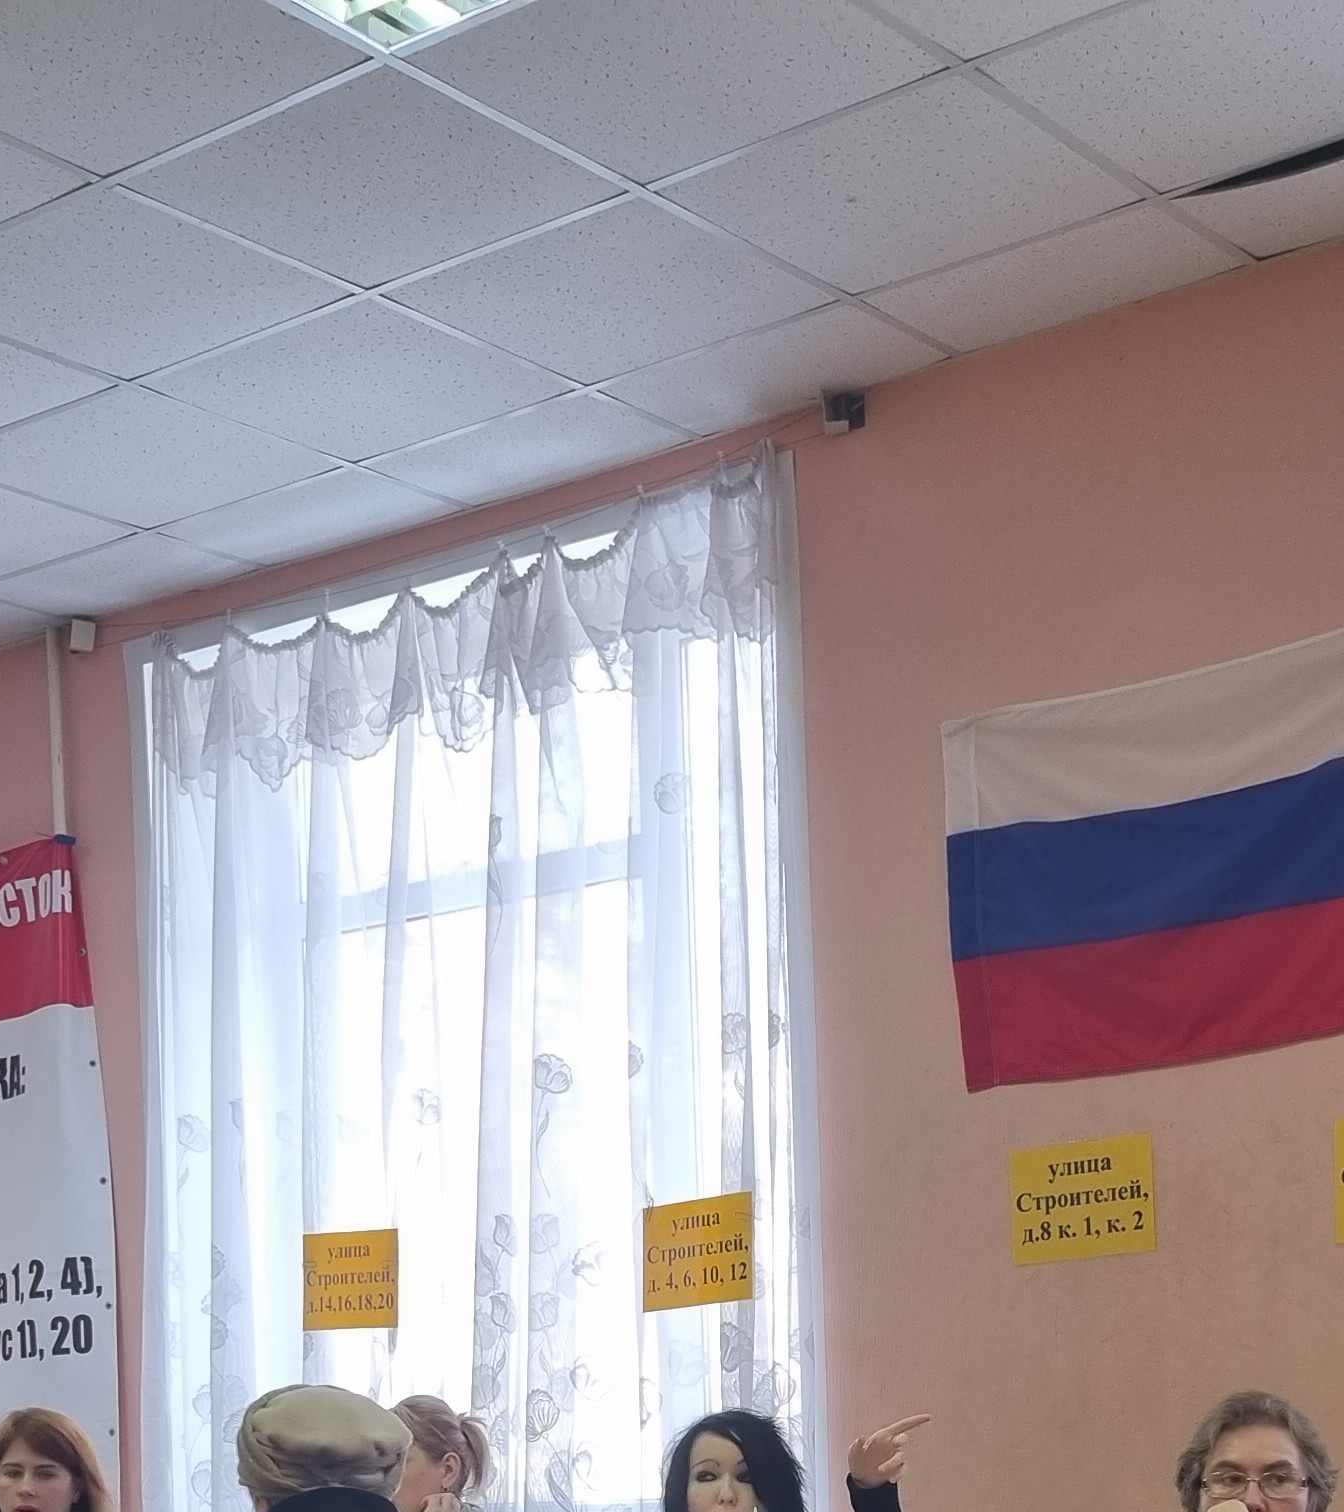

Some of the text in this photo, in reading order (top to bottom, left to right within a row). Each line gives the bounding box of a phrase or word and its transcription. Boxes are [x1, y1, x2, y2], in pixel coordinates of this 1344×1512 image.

[1047, 1155, 1113, 1185] улица
[1015, 1178, 1150, 1216] Строителей,
[671, 1212, 721, 1238] улица
[1021, 1209, 1145, 1247] д.8 к. 1, к. 2
[327, 1244, 371, 1265] улица
[646, 1232, 749, 1267] Строителей,
[27, 1258, 54, 1303] 2,
[60, 1255, 103, 1299] 4),
[306, 1265, 396, 1291] Строителей,
[646, 1261, 748, 1295] д. 4, 6, 10, 12
[16, 1318, 45, 1362] 1),
[50, 1313, 93, 1356] 20
